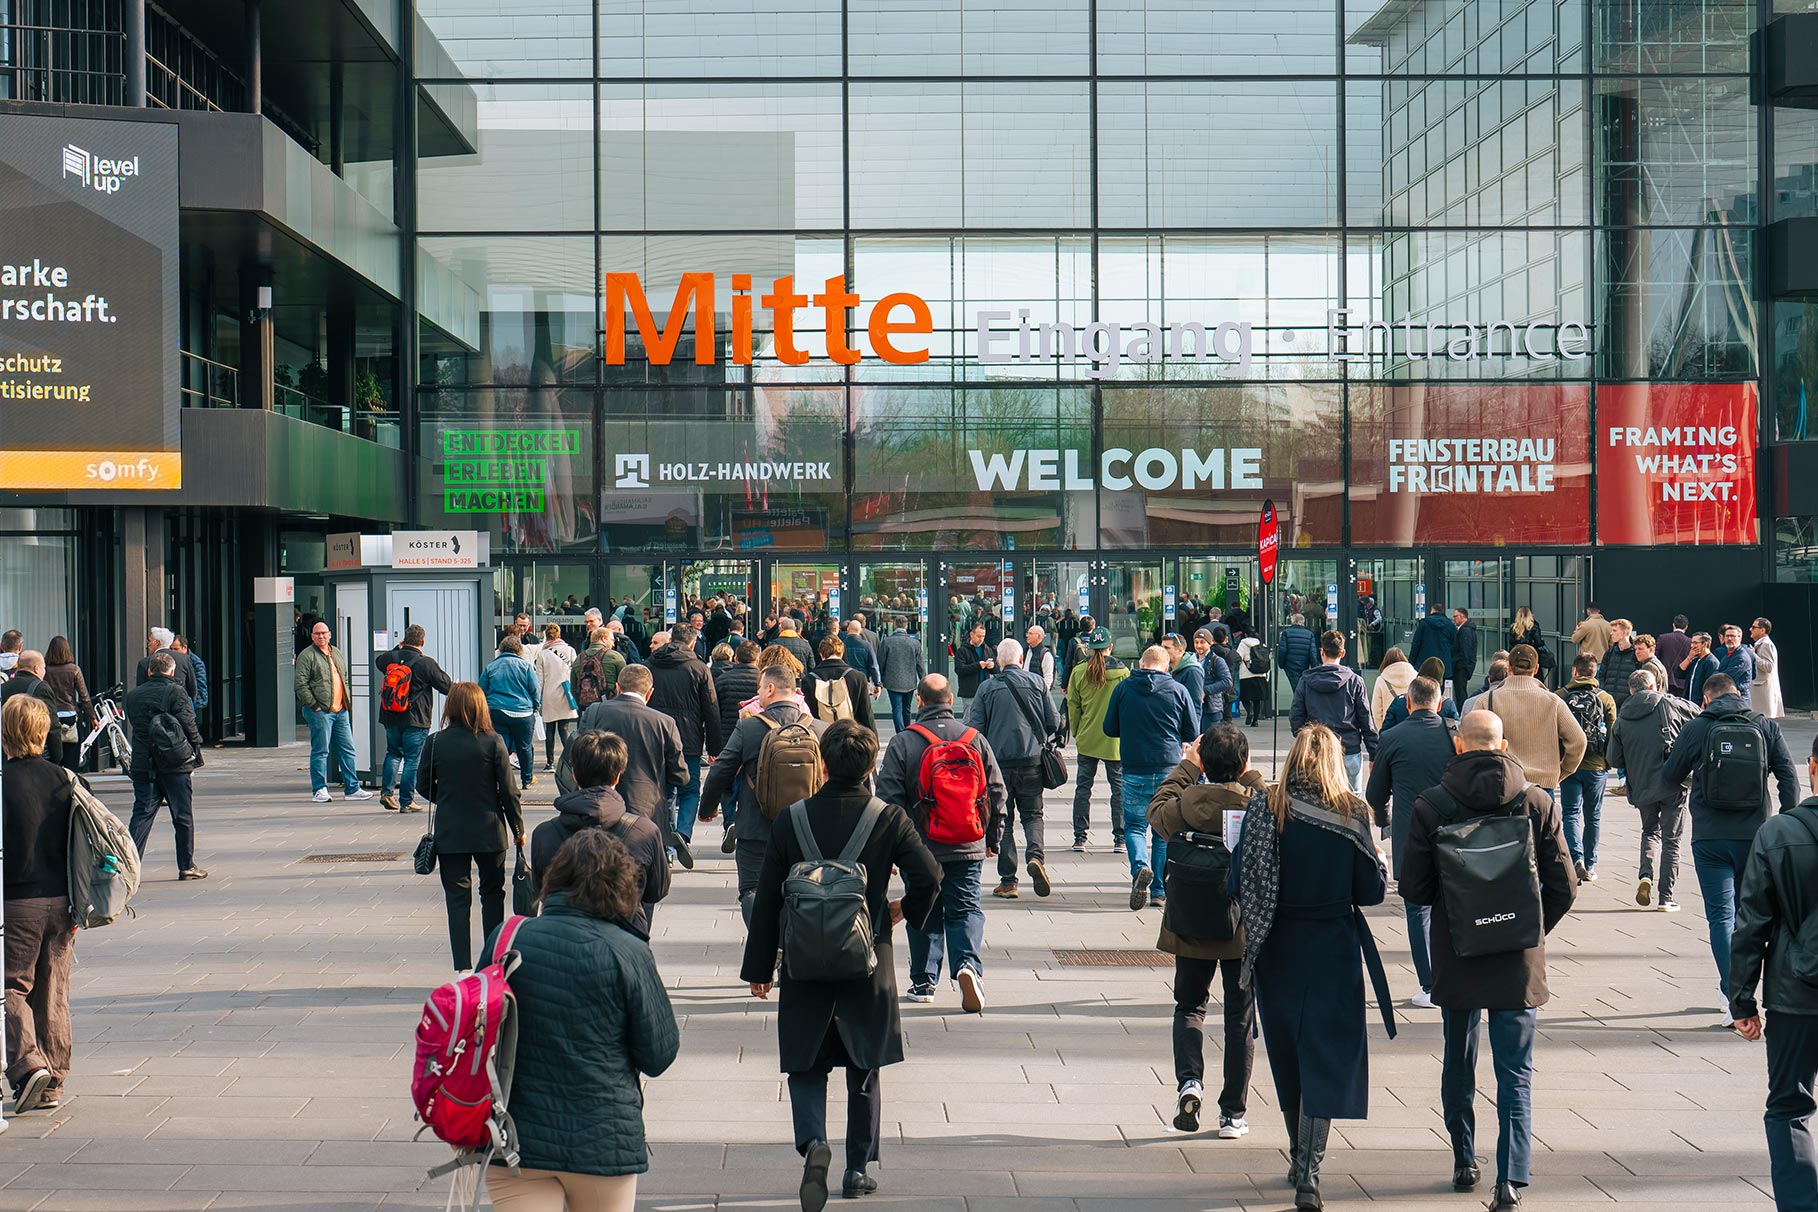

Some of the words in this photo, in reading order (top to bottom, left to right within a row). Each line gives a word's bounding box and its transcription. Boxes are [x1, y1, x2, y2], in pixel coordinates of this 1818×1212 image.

[93, 155, 139, 176] level
[1, 258, 68, 288] arke
[2, 293, 117, 323] rschaft.
[605, 271, 933, 365] Mitte
[976, 308, 1252, 378] Eingang
[1328, 308, 1589, 361] Entrance
[0, 380, 91, 402] tisierung
[449, 433, 575, 451] ENTDECKEN
[1609, 426, 1737, 447] FRAMING
[1389, 438, 1555, 463] FENSTERBAU
[86, 459, 160, 482] somfy
[449, 463, 541, 481] ERLEBEN
[659, 462, 832, 481] HOLZ-HANDWERK
[968, 447, 1264, 491] WELCOME
[1635, 453, 1737, 474] WHAT'S
[449, 492, 539, 510] MACHEN
[1662, 482, 1738, 501] NEXT.
[409, 539, 448, 549] KÖSTER
[430, 557, 453, 565] STAND
